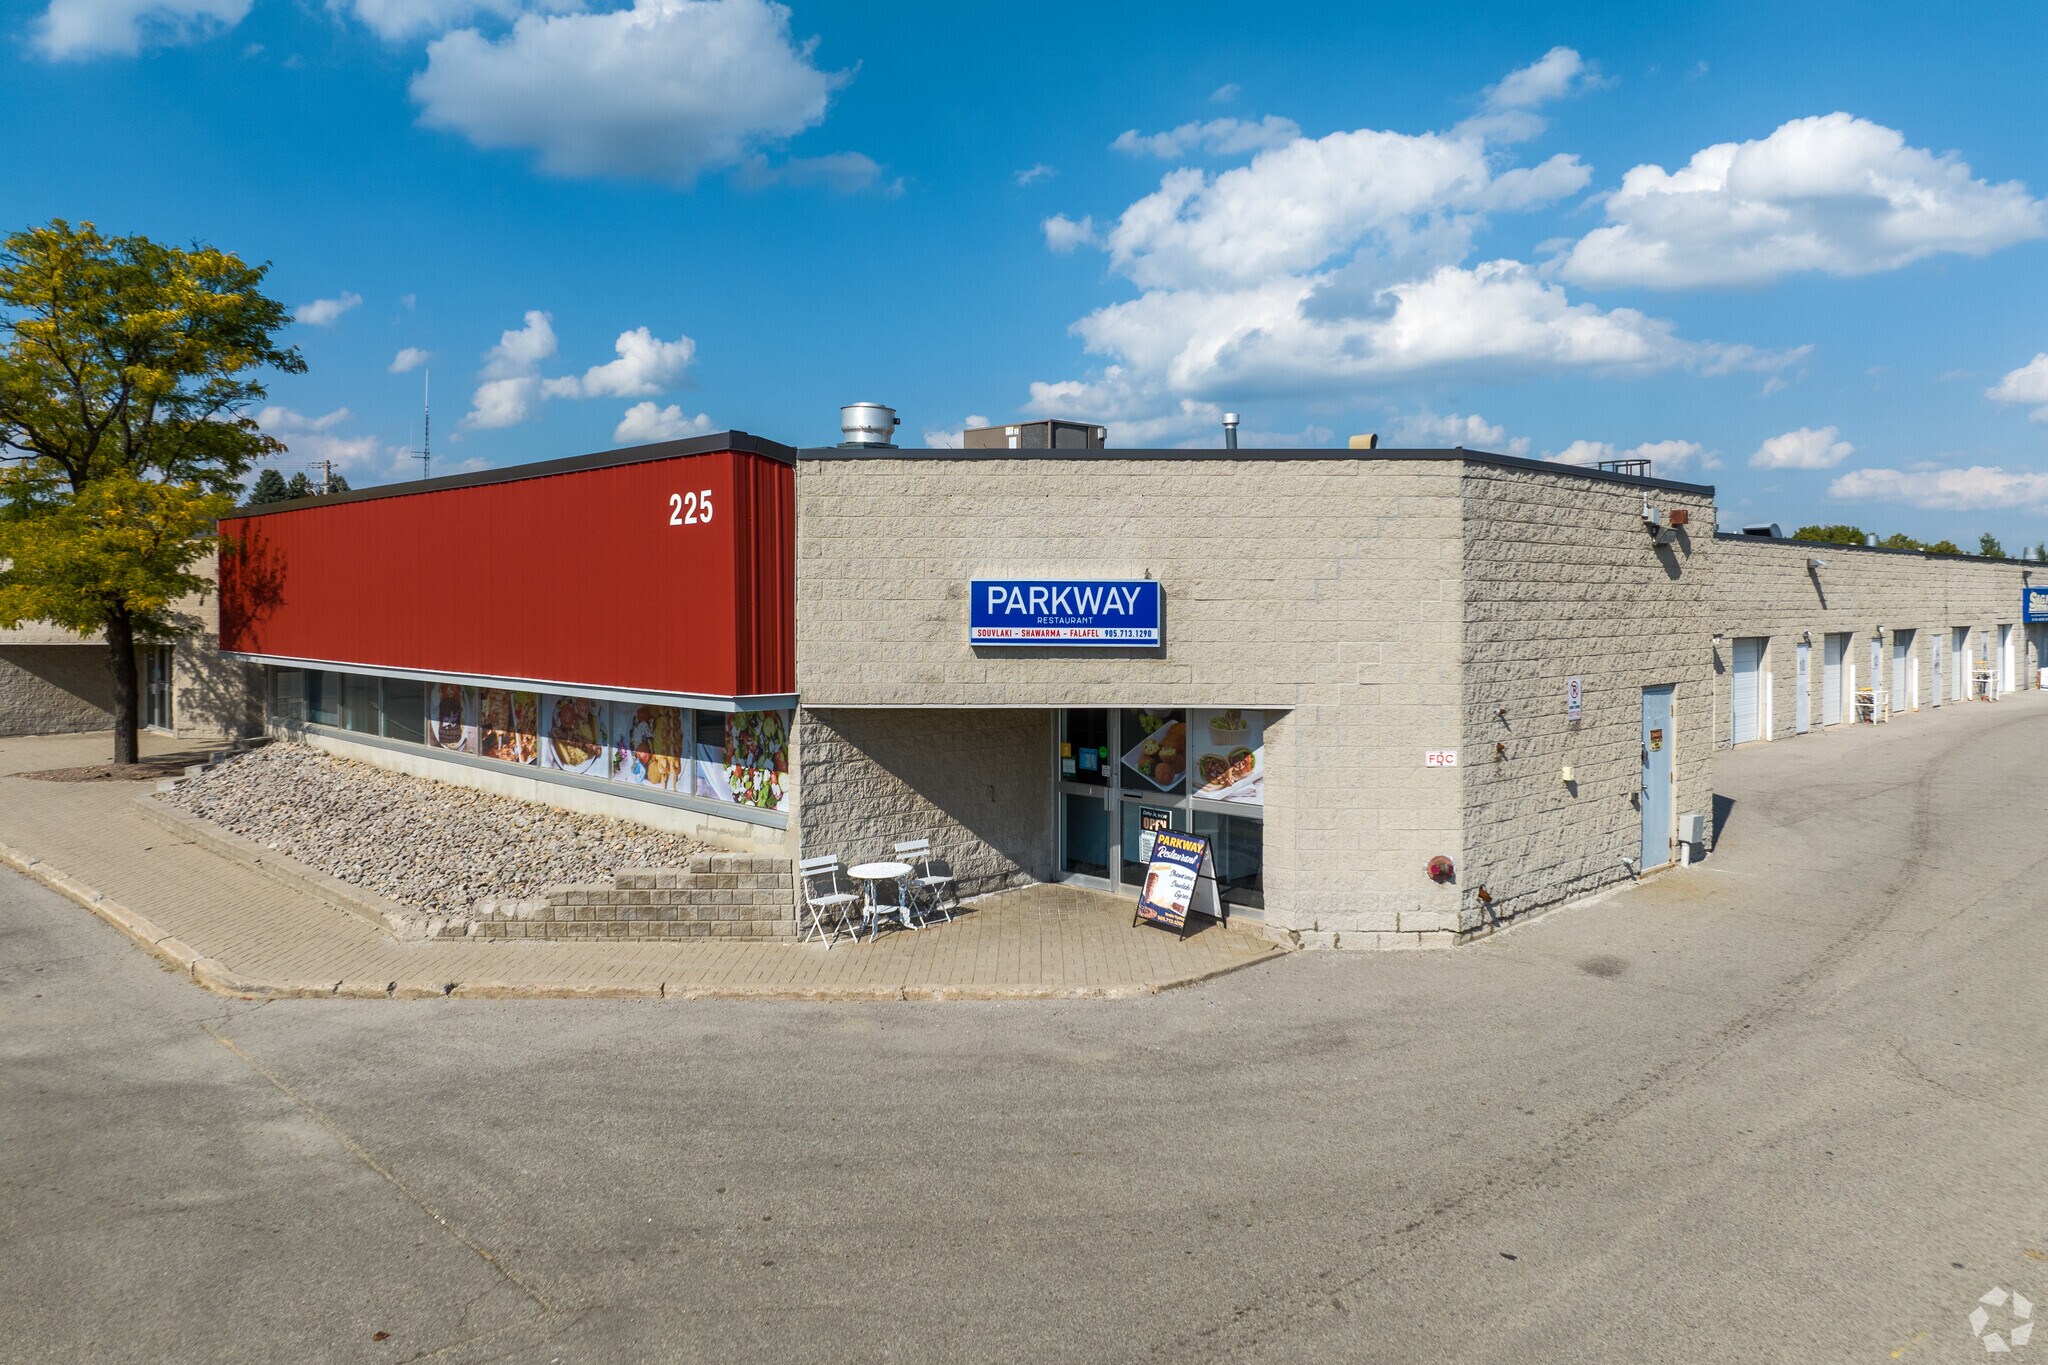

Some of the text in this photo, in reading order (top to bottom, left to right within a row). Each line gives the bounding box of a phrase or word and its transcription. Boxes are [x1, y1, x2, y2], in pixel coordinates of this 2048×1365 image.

[669, 489, 713, 525] 225
[988, 586, 1141, 615] PARKWAY
[1037, 616, 1093, 624] RESTAURANT
[977, 629, 1012, 637] SOUVLAKI
[1021, 629, 1061, 637] SHAWARMA
[1069, 629, 1100, 638] FALAFEL
[1104, 629, 1152, 638] 905.713.1290
[1429, 754, 1454, 764] FDC
[1143, 817, 1167, 831] OPEN
[1157, 834, 1205, 853] PARKWAY
[1157, 846, 1198, 865] Restaurant
